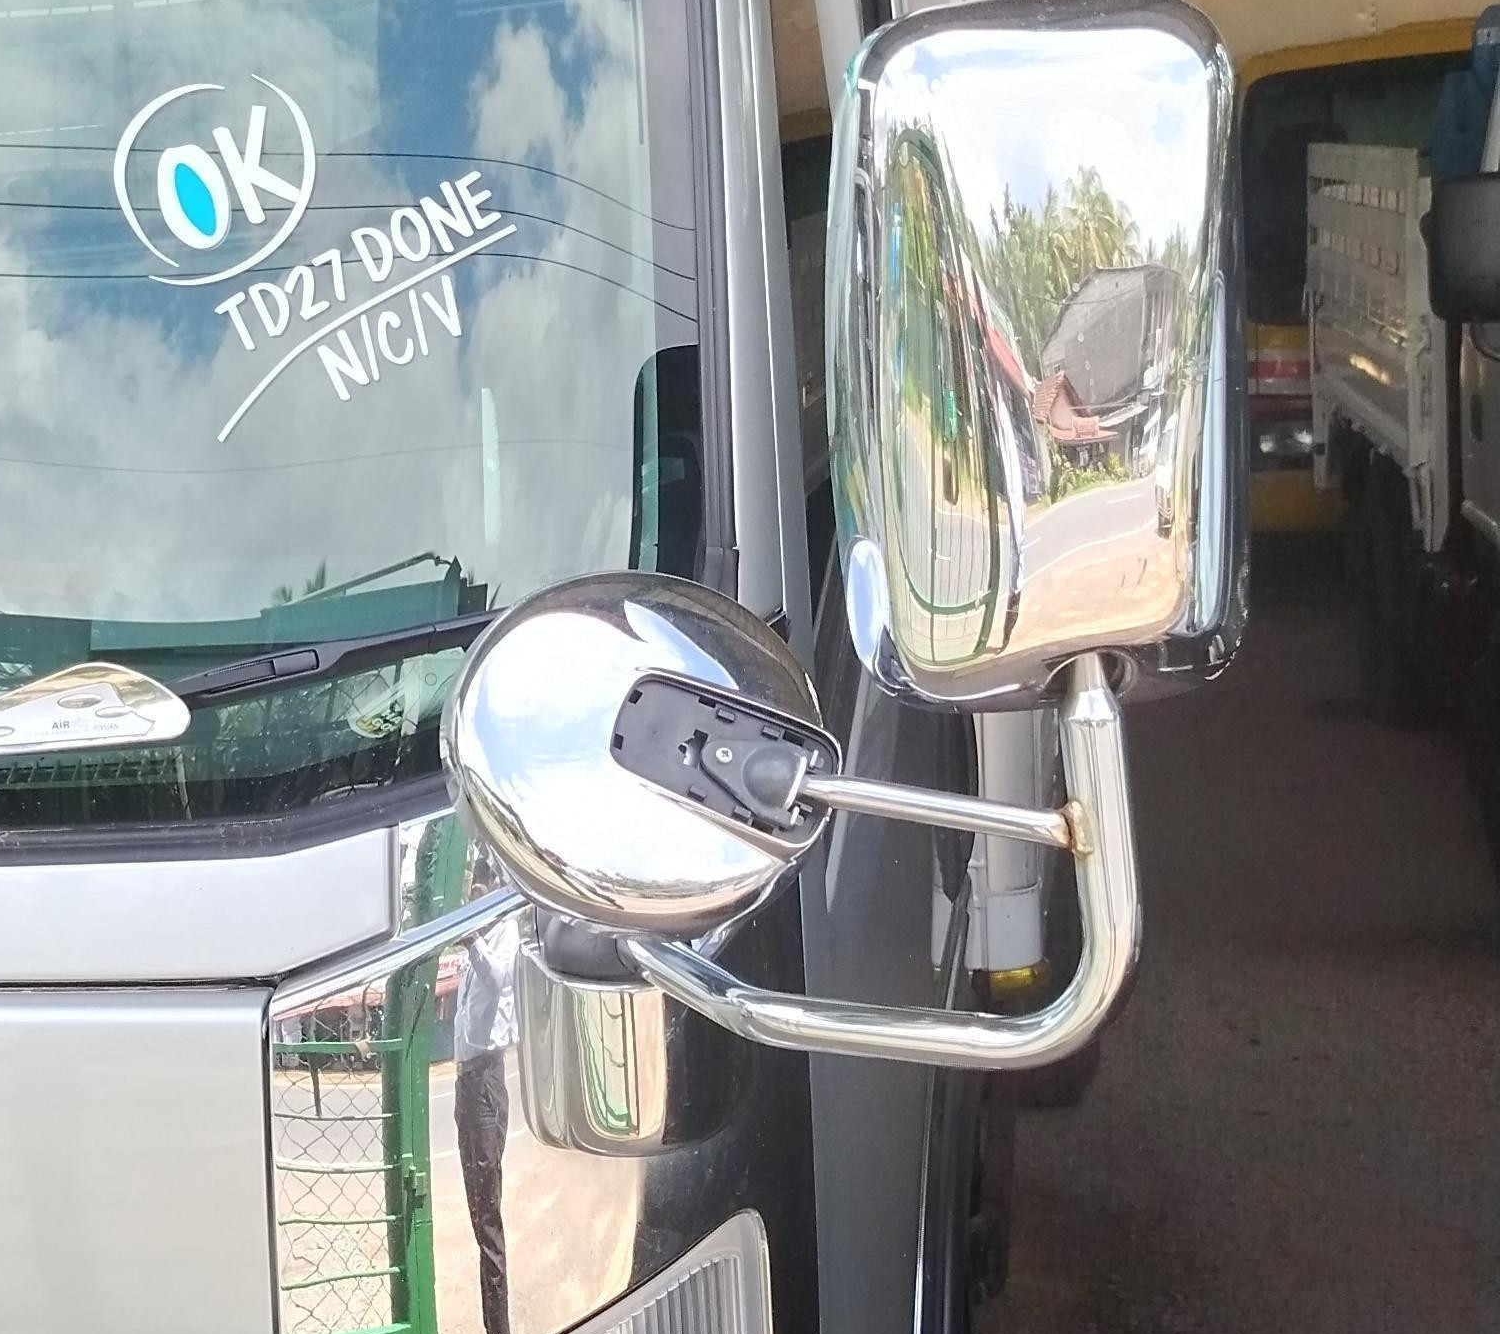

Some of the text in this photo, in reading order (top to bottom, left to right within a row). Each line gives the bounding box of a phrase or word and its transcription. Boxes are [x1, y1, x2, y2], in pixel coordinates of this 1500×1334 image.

[157, 105, 300, 250] OK
[214, 170, 502, 351] TD27 DONE
